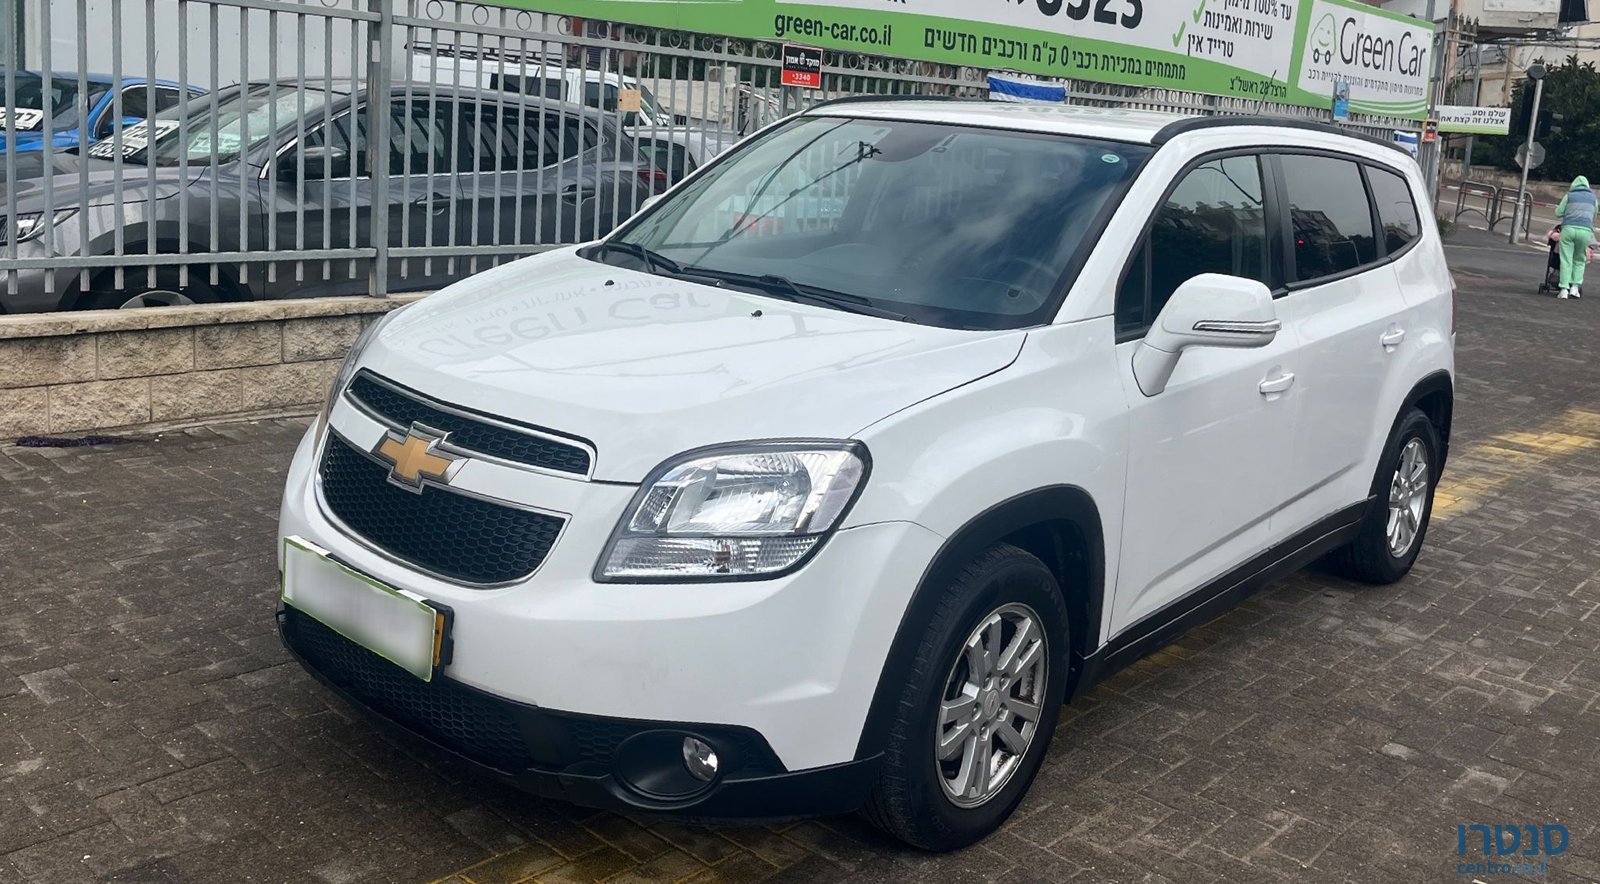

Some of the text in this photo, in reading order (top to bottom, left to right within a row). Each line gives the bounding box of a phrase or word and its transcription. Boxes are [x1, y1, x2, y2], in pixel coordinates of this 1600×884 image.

[1280, 3, 1292, 20] עד
[774, 14, 892, 46] green-car.co.il
[1203, 10, 1273, 41] שירות ואמינות
[924, 27, 977, 54] חדשים
[981, 36, 1028, 61] ורכבים
[1187, 34, 1234, 58] טרייד אין
[1340, 17, 1427, 77] Green Car
[1060, 45, 1069, 67] 0
[1072, 50, 1099, 70] רכבי
[1100, 54, 1141, 75] במכירת
[1145, 60, 1186, 80] מתמחים
